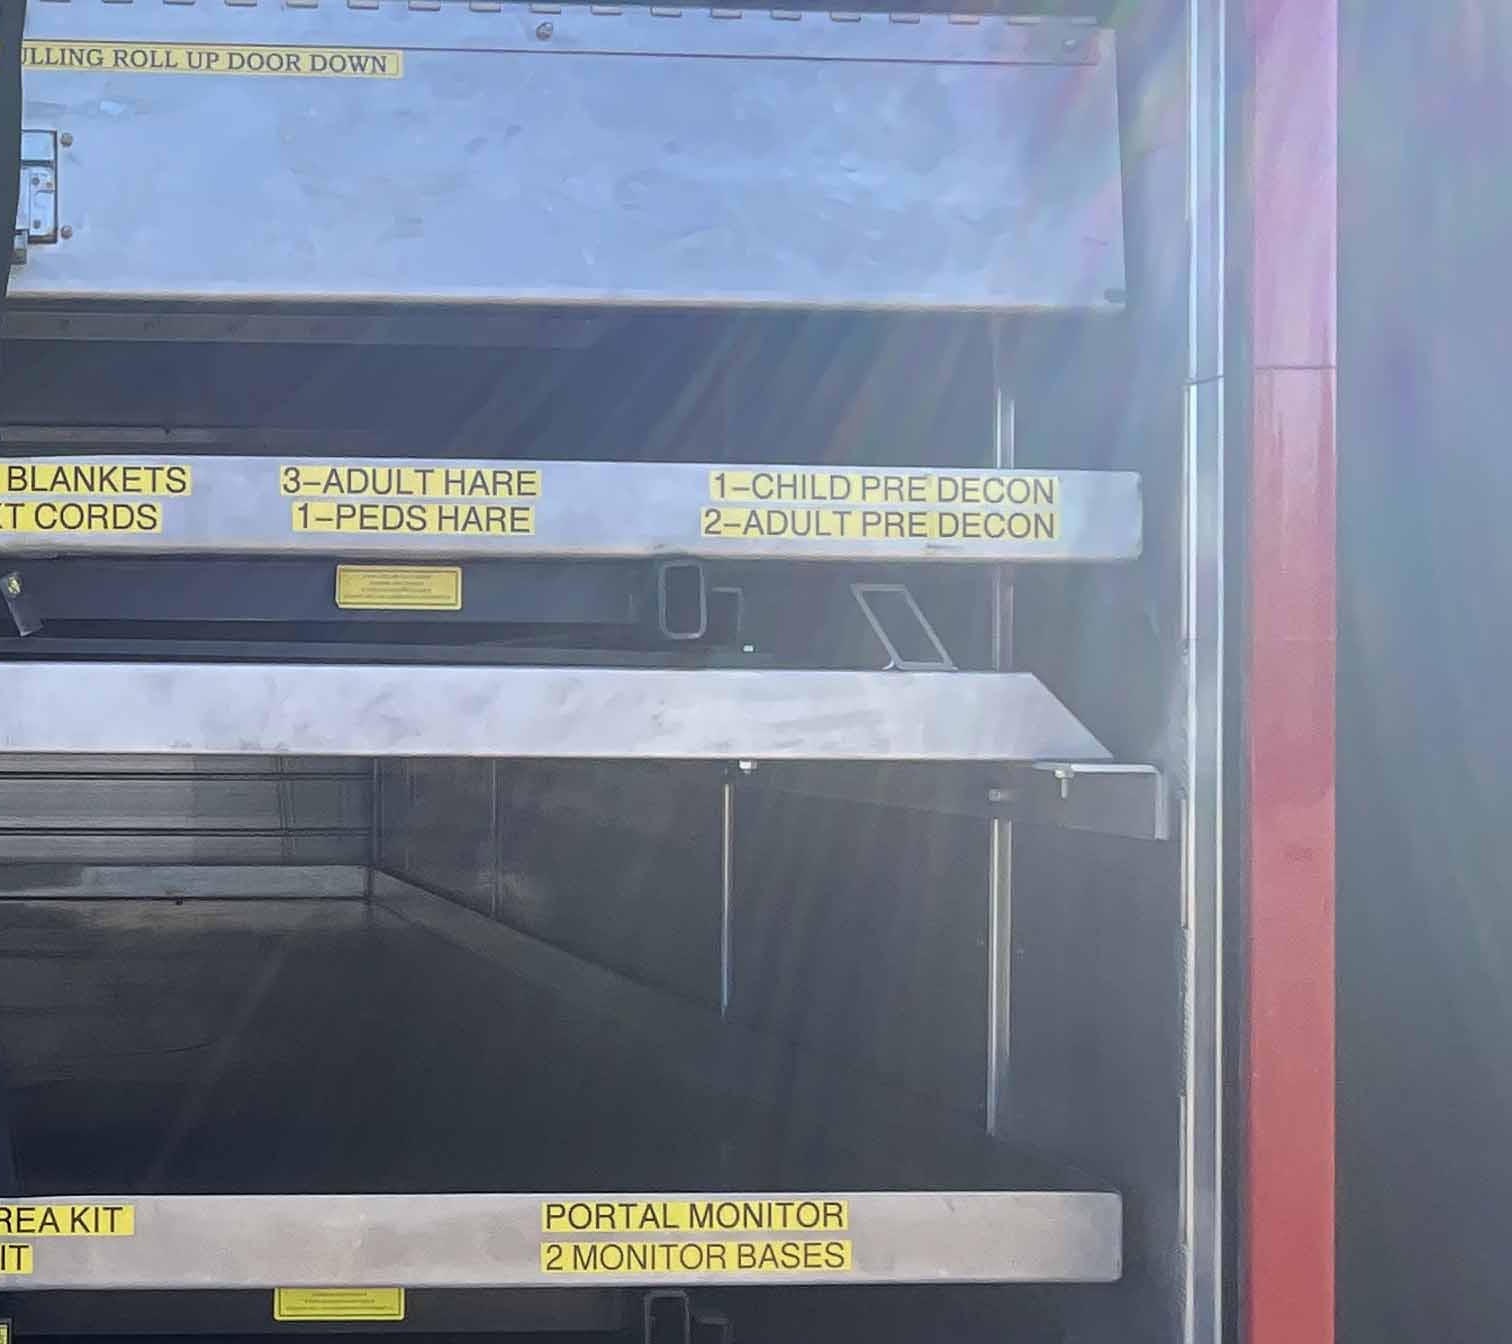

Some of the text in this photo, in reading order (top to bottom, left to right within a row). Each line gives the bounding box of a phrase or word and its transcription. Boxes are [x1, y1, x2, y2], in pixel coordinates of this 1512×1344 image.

[112, 49, 178, 68] ROLL
[188, 51, 219, 70] UP
[227, 52, 301, 72] DOOR
[310, 53, 388, 73] DOWN
[7, 465, 187, 493] BLANKETS
[283, 467, 537, 496] 3-ADULT HARE
[714, 473, 1054, 504] 1-CHILD PRE DECON
[34, 503, 157, 530] CORDS
[298, 502, 530, 533] 1-PEDS HARE
[704, 509, 1054, 538] 2-ADULT PRE DECON
[70, 1207, 123, 1233] KIT
[546, 1202, 843, 1229] PORTAL MONITOR
[546, 1242, 844, 1270] 2 MONITOR BASES
